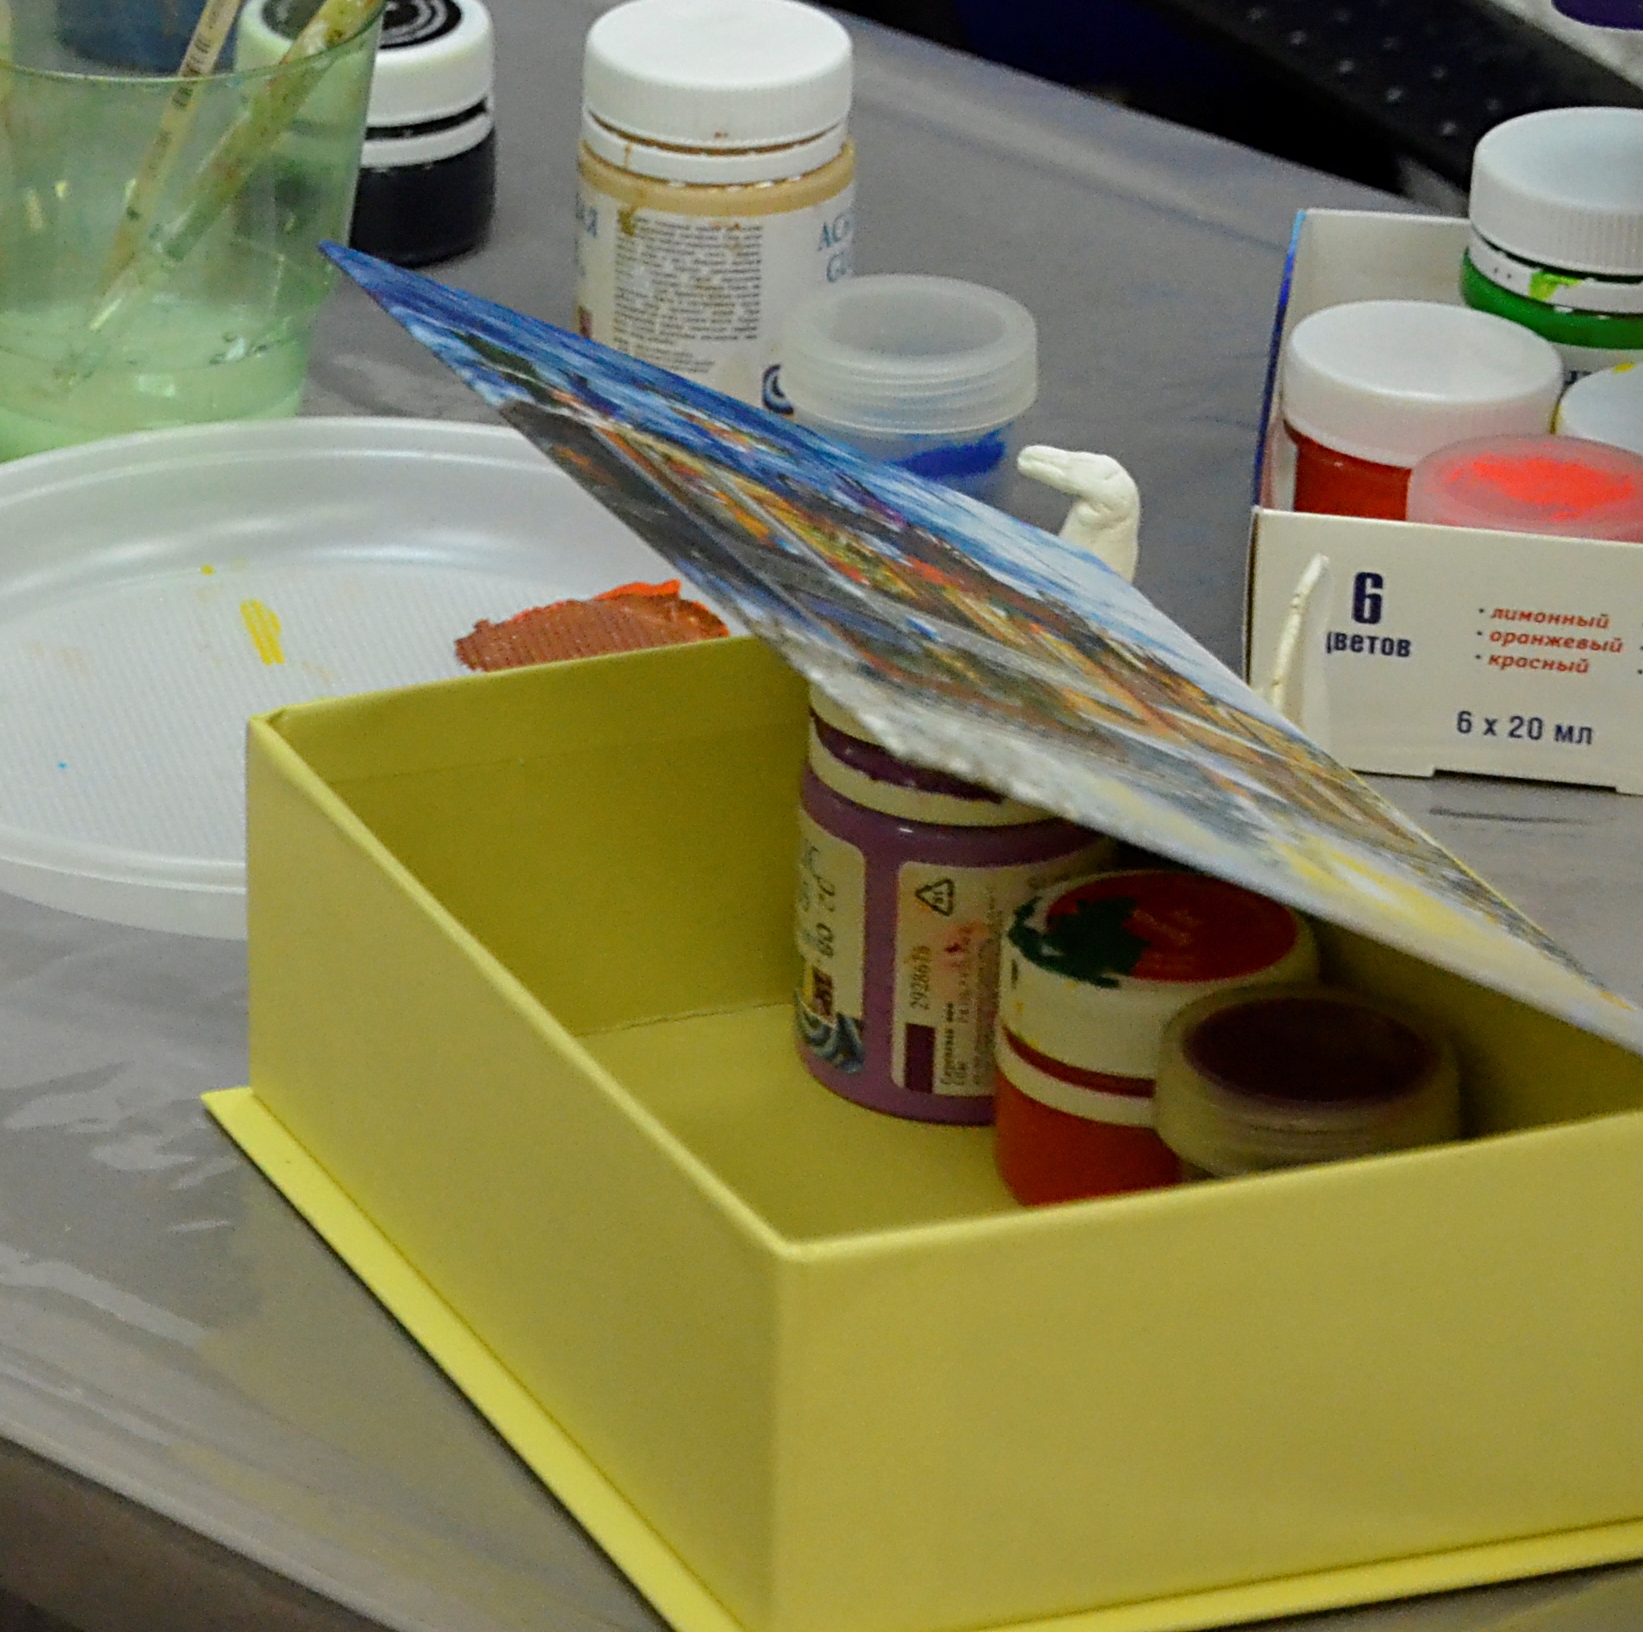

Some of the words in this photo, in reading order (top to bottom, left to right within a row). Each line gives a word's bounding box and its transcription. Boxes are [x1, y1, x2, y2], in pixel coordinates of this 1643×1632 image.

[1351, 571, 1384, 625] 6
[1490, 607, 1611, 630] лимонный
[1489, 630, 1624, 654] оранжевый
[1487, 653, 1590, 674] красный
[1456, 710, 1473, 735] 6
[1508, 715, 1544, 742] 20
[1554, 724, 1594, 745] мл
